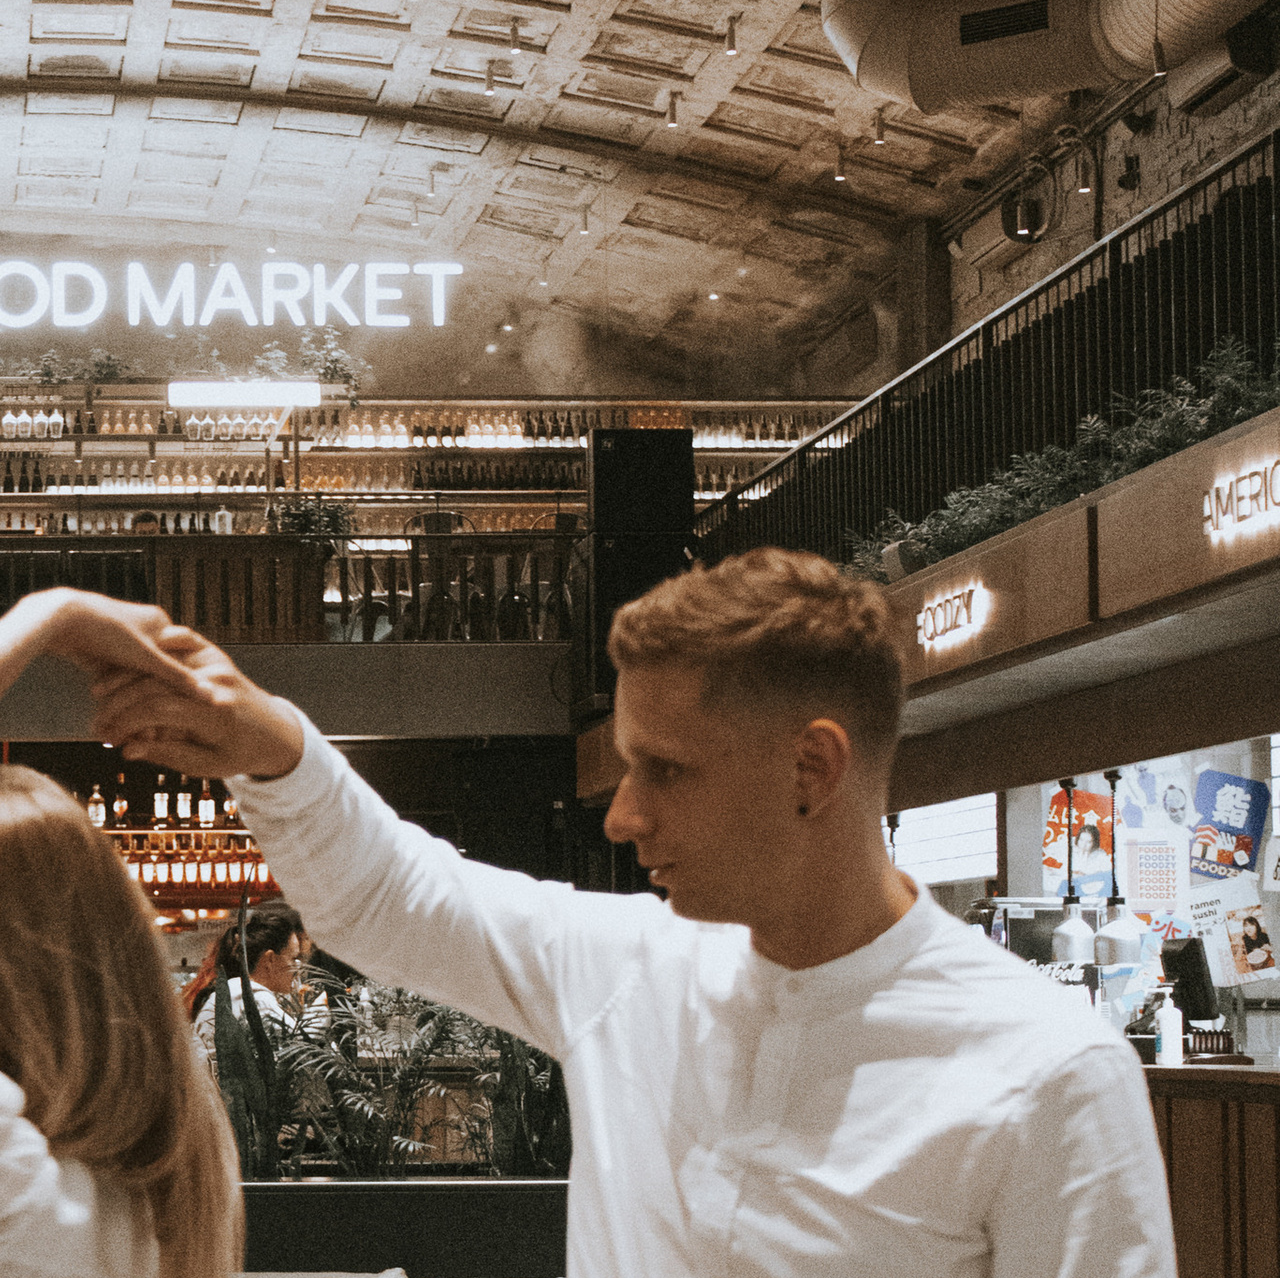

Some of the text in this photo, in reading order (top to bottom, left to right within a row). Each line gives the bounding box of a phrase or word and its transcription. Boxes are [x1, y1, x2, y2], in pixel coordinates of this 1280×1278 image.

[128, 262, 463, 326] MARKET
[1139, 869, 1176, 877] FOODZY
[1139, 884, 1177, 892] FOODZY
[1190, 898, 1221, 911] ramen
[1192, 909, 1218, 920] sushi
